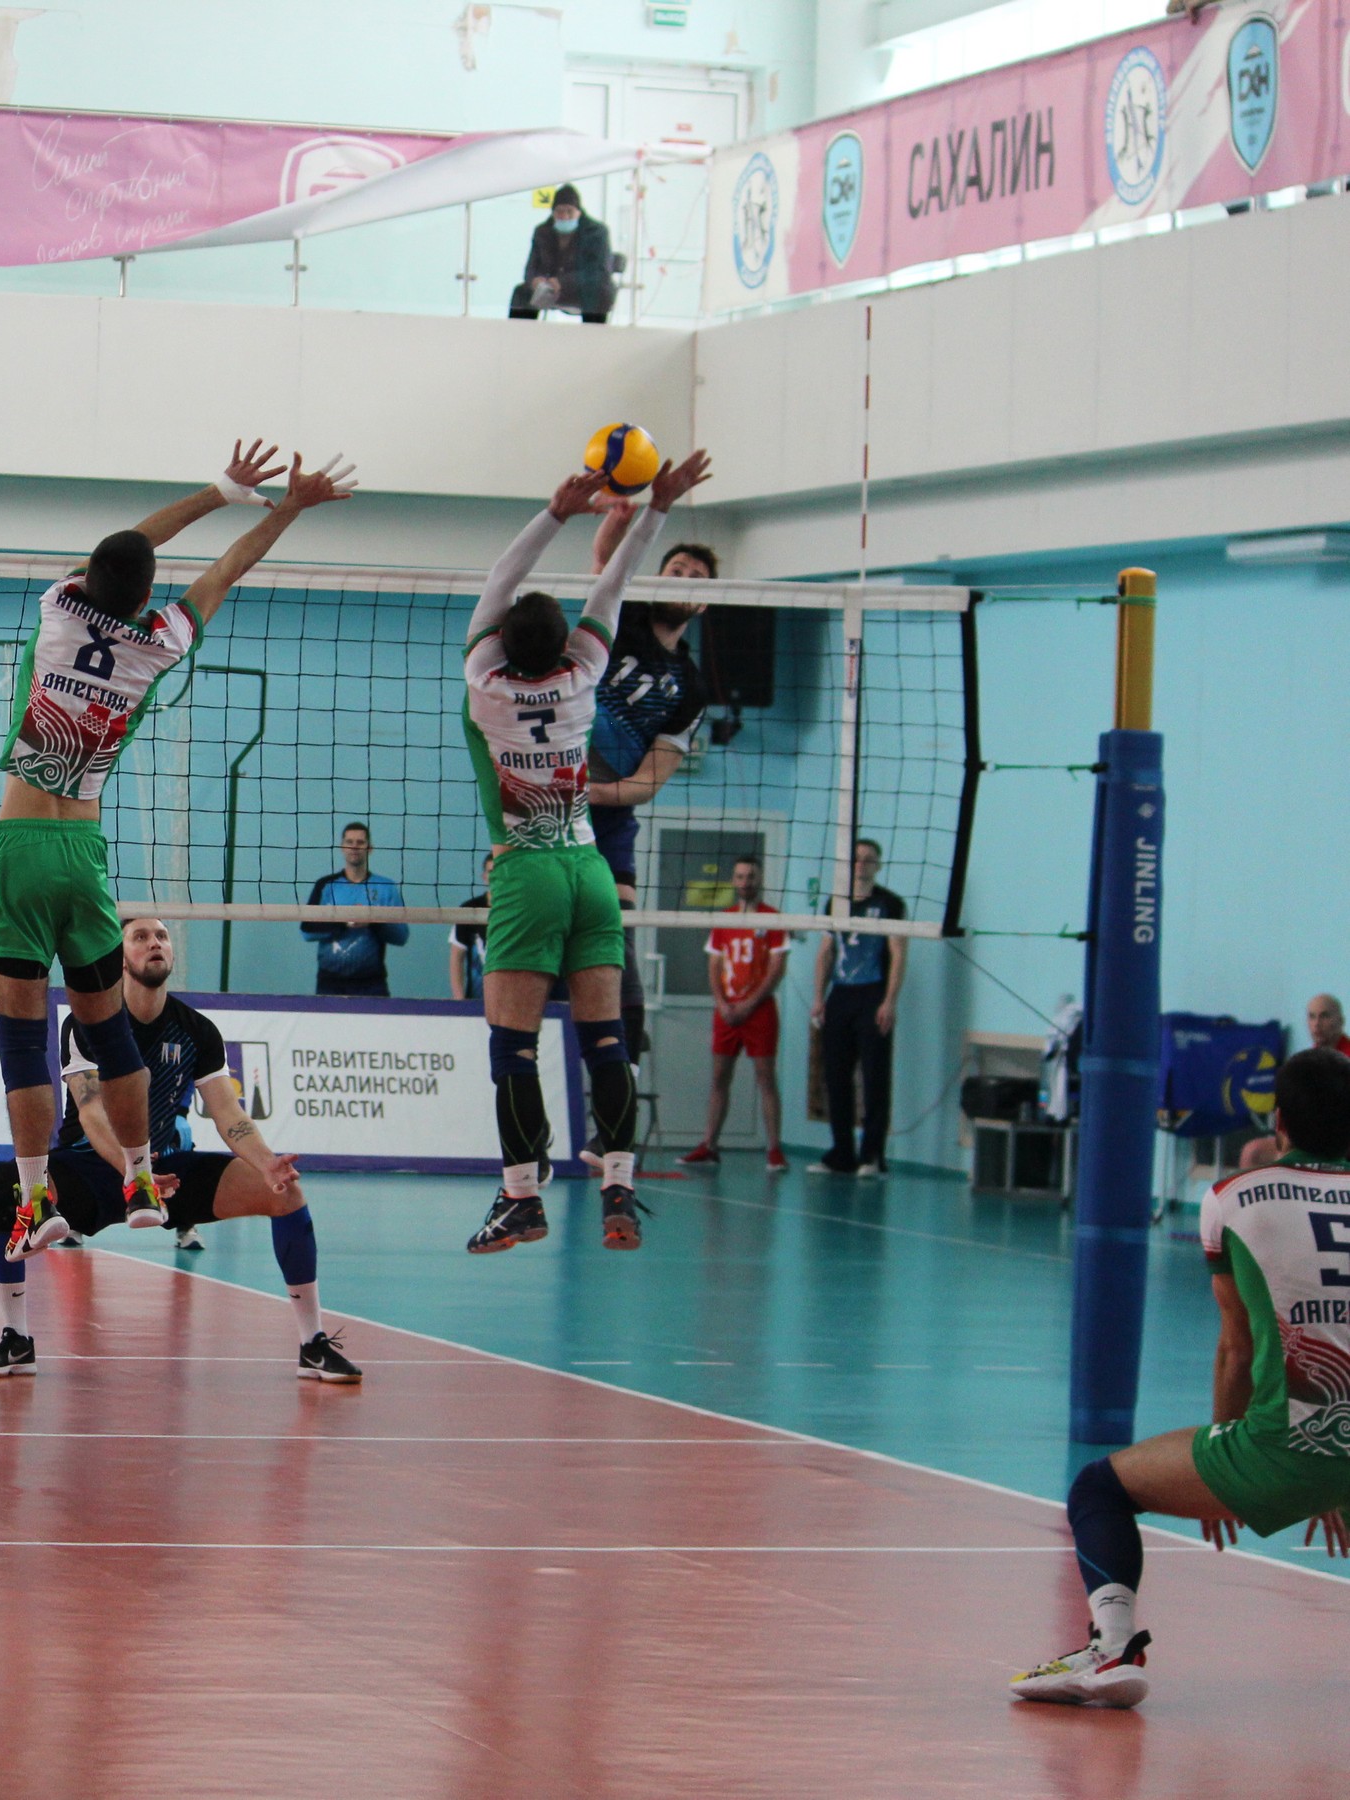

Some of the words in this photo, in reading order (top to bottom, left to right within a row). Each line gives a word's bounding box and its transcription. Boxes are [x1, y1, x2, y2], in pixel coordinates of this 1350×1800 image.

[908, 106, 1055, 219] САХАЛИН
[73, 623, 121, 681] 8
[42, 673, 129, 712] ДАГЕСТАН
[517, 708, 556, 744] 7
[500, 747, 583, 769] ДАГЕСТАН
[1133, 837, 1157, 944] JINLING
[730, 938, 754, 963] 13
[292, 1050, 455, 1071] ПРАВИТЕЛЬСТВО
[293, 1073, 439, 1096] САХАЛИНСКОЙ
[295, 1099, 385, 1119] ОБЛАСТИ
[1308, 1211, 1350, 1287] 5
[1290, 1300, 1350, 1325] ДАГЕ
